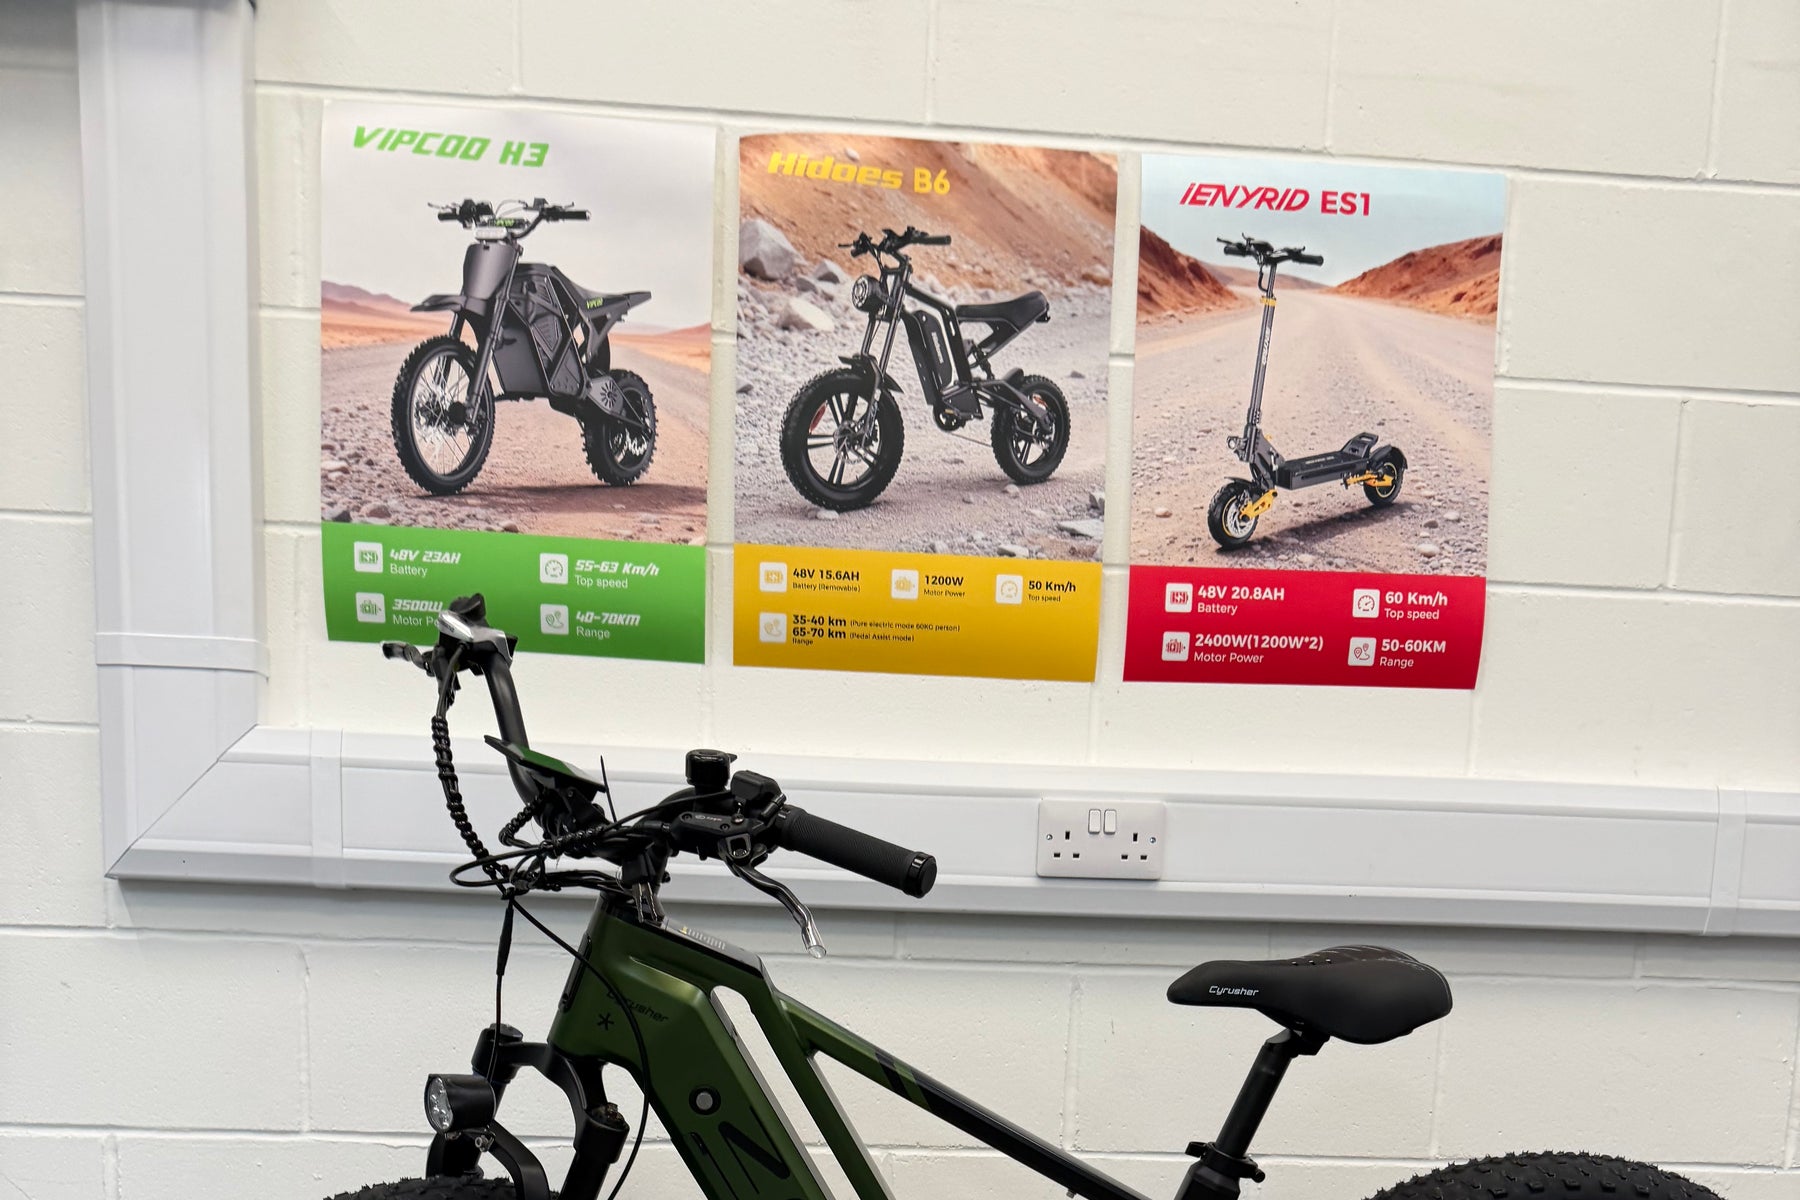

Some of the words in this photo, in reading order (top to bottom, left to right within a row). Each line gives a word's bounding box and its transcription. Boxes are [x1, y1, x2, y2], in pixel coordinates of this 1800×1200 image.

[499, 140, 550, 168] H3
[767, 151, 904, 190] Hidoes
[914, 166, 951, 195] B6
[1320, 190, 1371, 217] ES1
[389, 549, 419, 561] 48V
[422, 550, 461, 565] 23AH
[390, 563, 428, 578] Battery
[575, 559, 619, 574] 55-63
[622, 562, 660, 577] Km/h
[792, 568, 816, 579] 48V
[818, 569, 860, 582] 15.6AH
[575, 574, 594, 588] Top
[596, 577, 628, 589] speed
[792, 582, 817, 591] Battery
[924, 575, 964, 587] 1200W
[1028, 580, 1042, 590] 50
[1045, 581, 1076, 593] Km/h
[923, 588, 943, 597] Motor
[944, 589, 965, 598] Power
[1028, 594, 1040, 602] Top
[1041, 594, 1061, 602] speed
[1198, 585, 1228, 599] 48V
[1231, 586, 1285, 601] 20.8AH
[1385, 591, 1404, 604] 60
[1407, 590, 1448, 607] Km/h
[392, 598, 443, 613] 3500W
[1197, 602, 1238, 616] Battery
[393, 613, 423, 626] Motor
[792, 614, 825, 626] 35-40
[828, 616, 847, 627] km
[1384, 607, 1405, 621] Top
[1406, 609, 1440, 621] speed
[576, 626, 611, 640] Range
[792, 626, 825, 638] 65-70
[827, 628, 846, 639] km
[792, 637, 814, 645] Range
[1381, 638, 1446, 654] 50-60KM
[1194, 651, 1227, 663] Motor
[1229, 652, 1265, 663] Power
[1380, 656, 1414, 670] Range
[1208, 985, 1259, 997] Cyrusher
